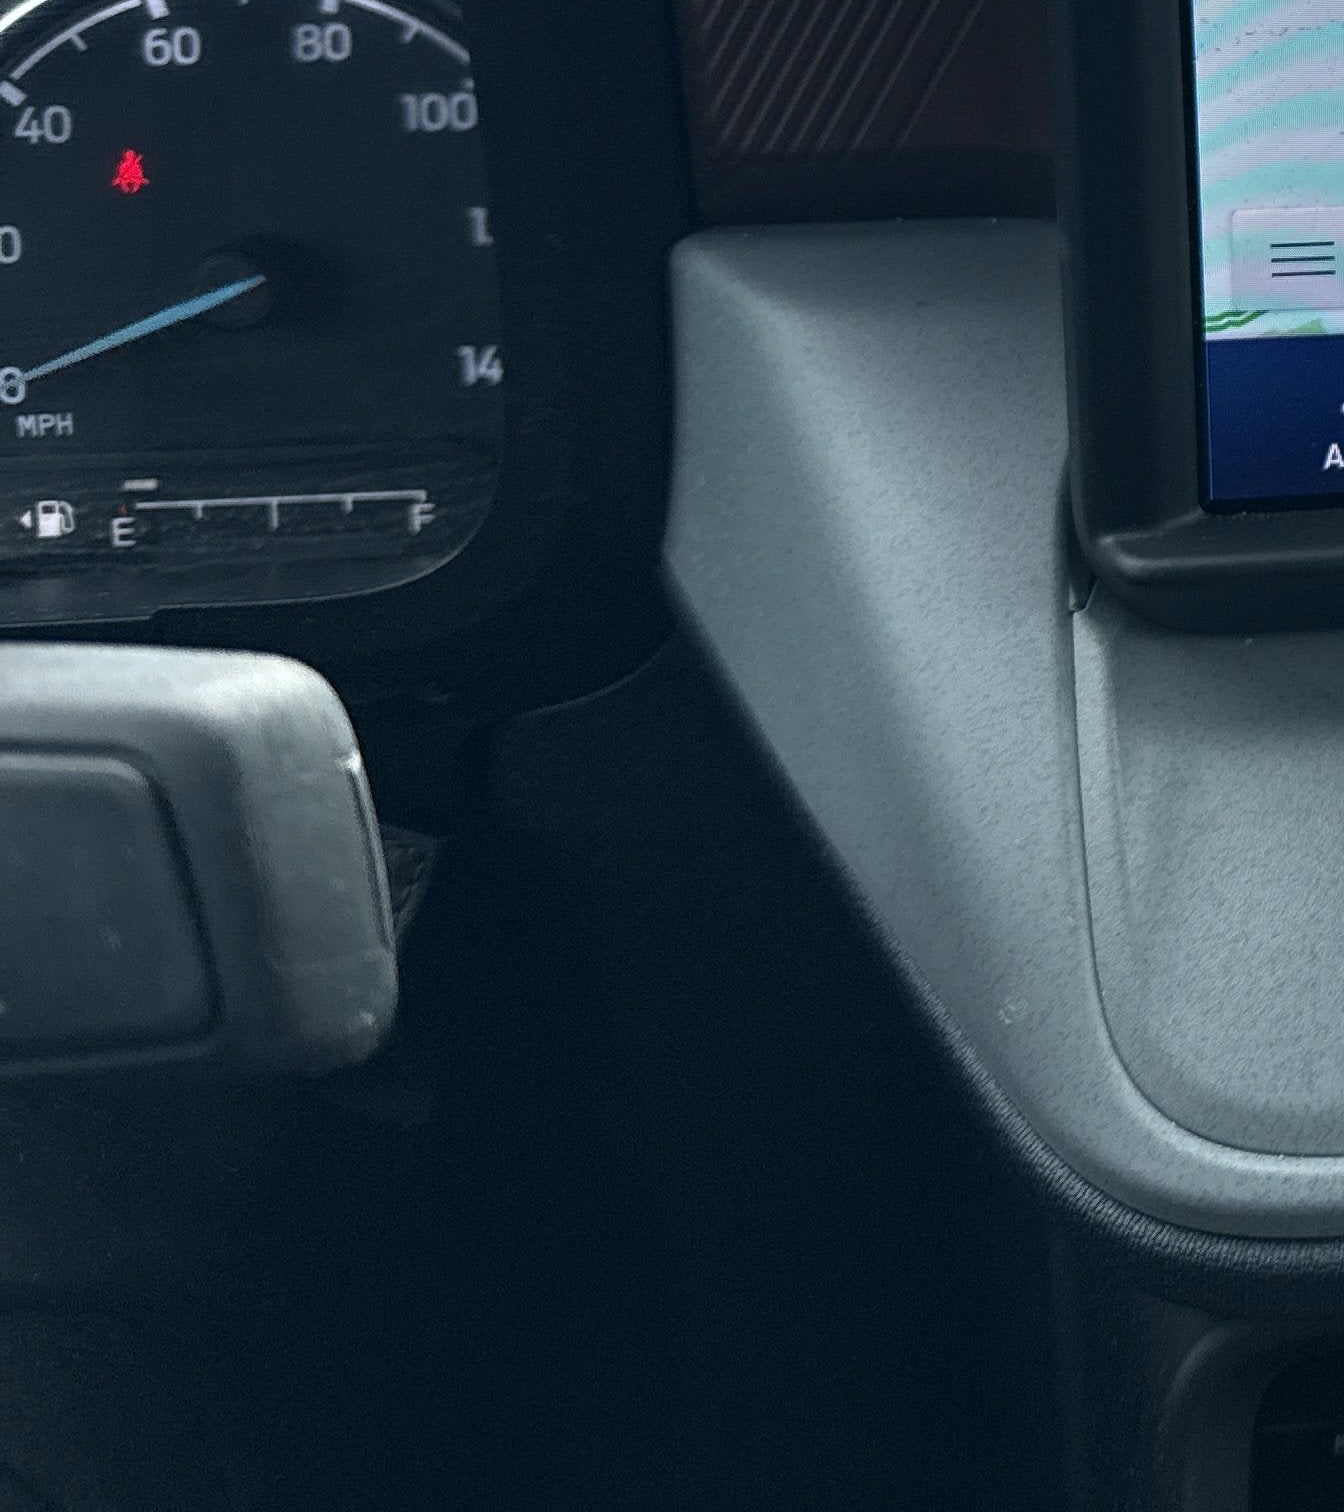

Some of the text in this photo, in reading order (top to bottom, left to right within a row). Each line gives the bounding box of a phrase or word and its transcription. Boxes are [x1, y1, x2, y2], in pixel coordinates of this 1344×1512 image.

[143, 27, 201, 65] 60
[296, 23, 353, 61] 80
[14, 105, 72, 144] 40
[404, 92, 479, 131] 100
[16, 413, 74, 437] MPH
[111, 518, 137, 546] E
